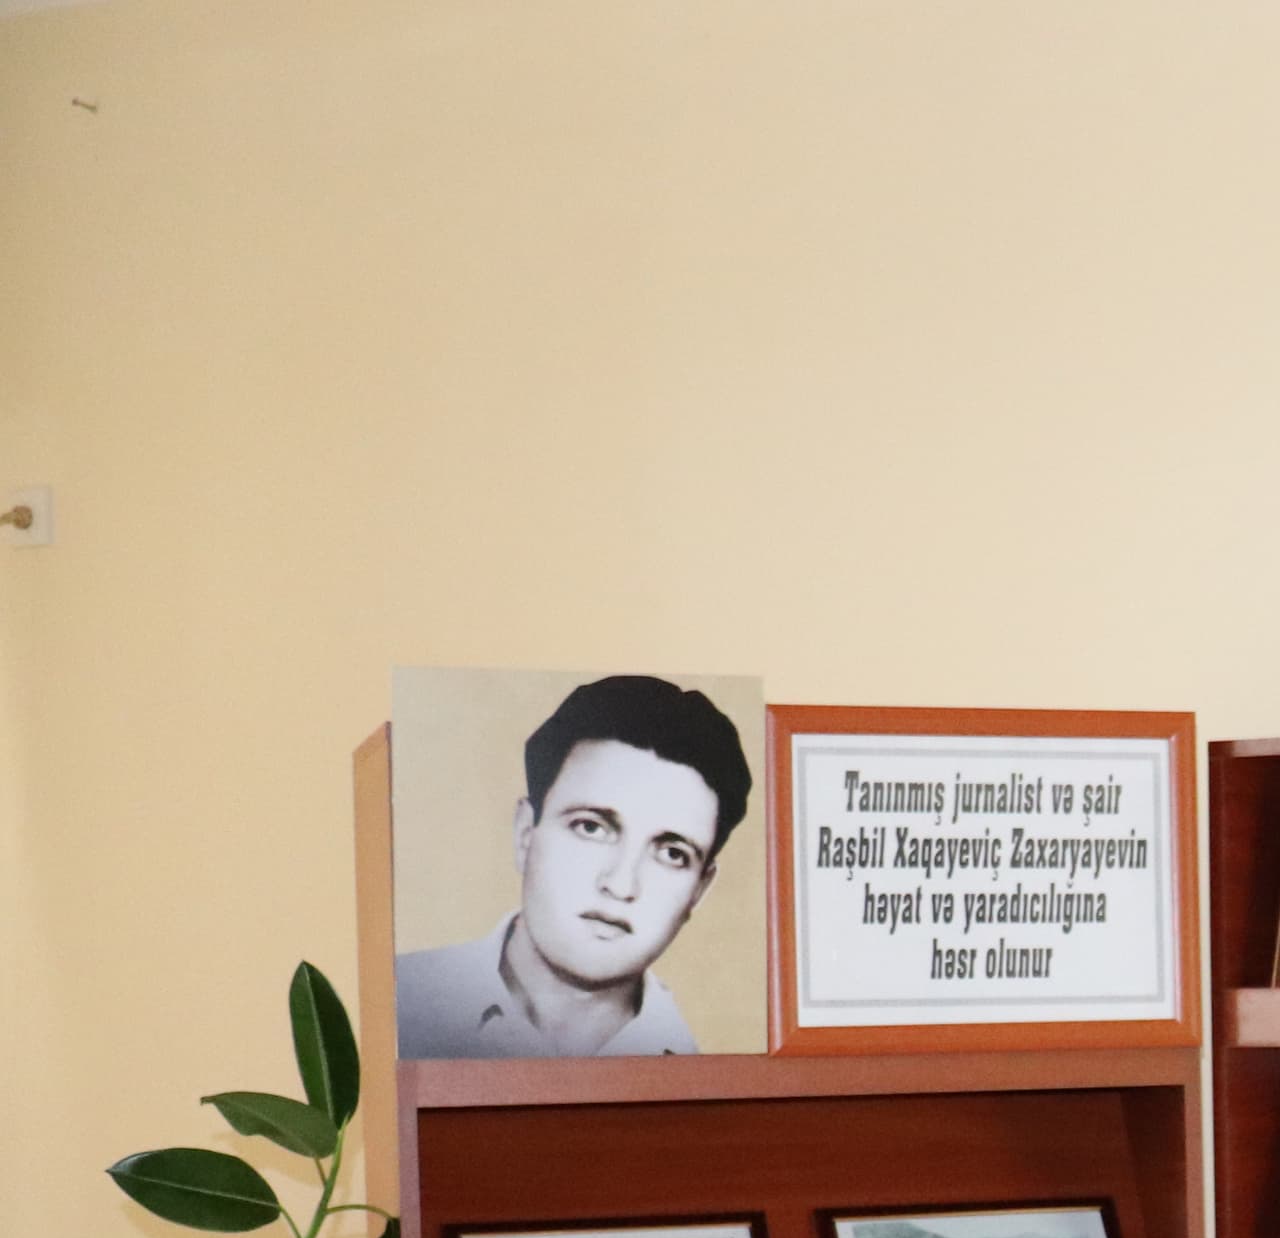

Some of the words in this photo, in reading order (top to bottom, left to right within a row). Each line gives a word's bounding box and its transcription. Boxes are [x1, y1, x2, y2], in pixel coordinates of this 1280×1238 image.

[844, 770, 945, 826] Tanınmış
[952, 773, 1043, 823] jurnalist
[1051, 783, 1075, 815] və
[1082, 775, 1122, 826] şair
[816, 826, 886, 881] Raşbil
[893, 827, 1001, 881] Xaqayeviç
[1010, 827, 1148, 880] Zaxaryayevin
[862, 883, 922, 934] həyat
[931, 893, 955, 923] və
[964, 880, 1107, 934] yaradıcılığına
[930, 938, 977, 980] həsr
[985, 939, 1054, 979] olunur
